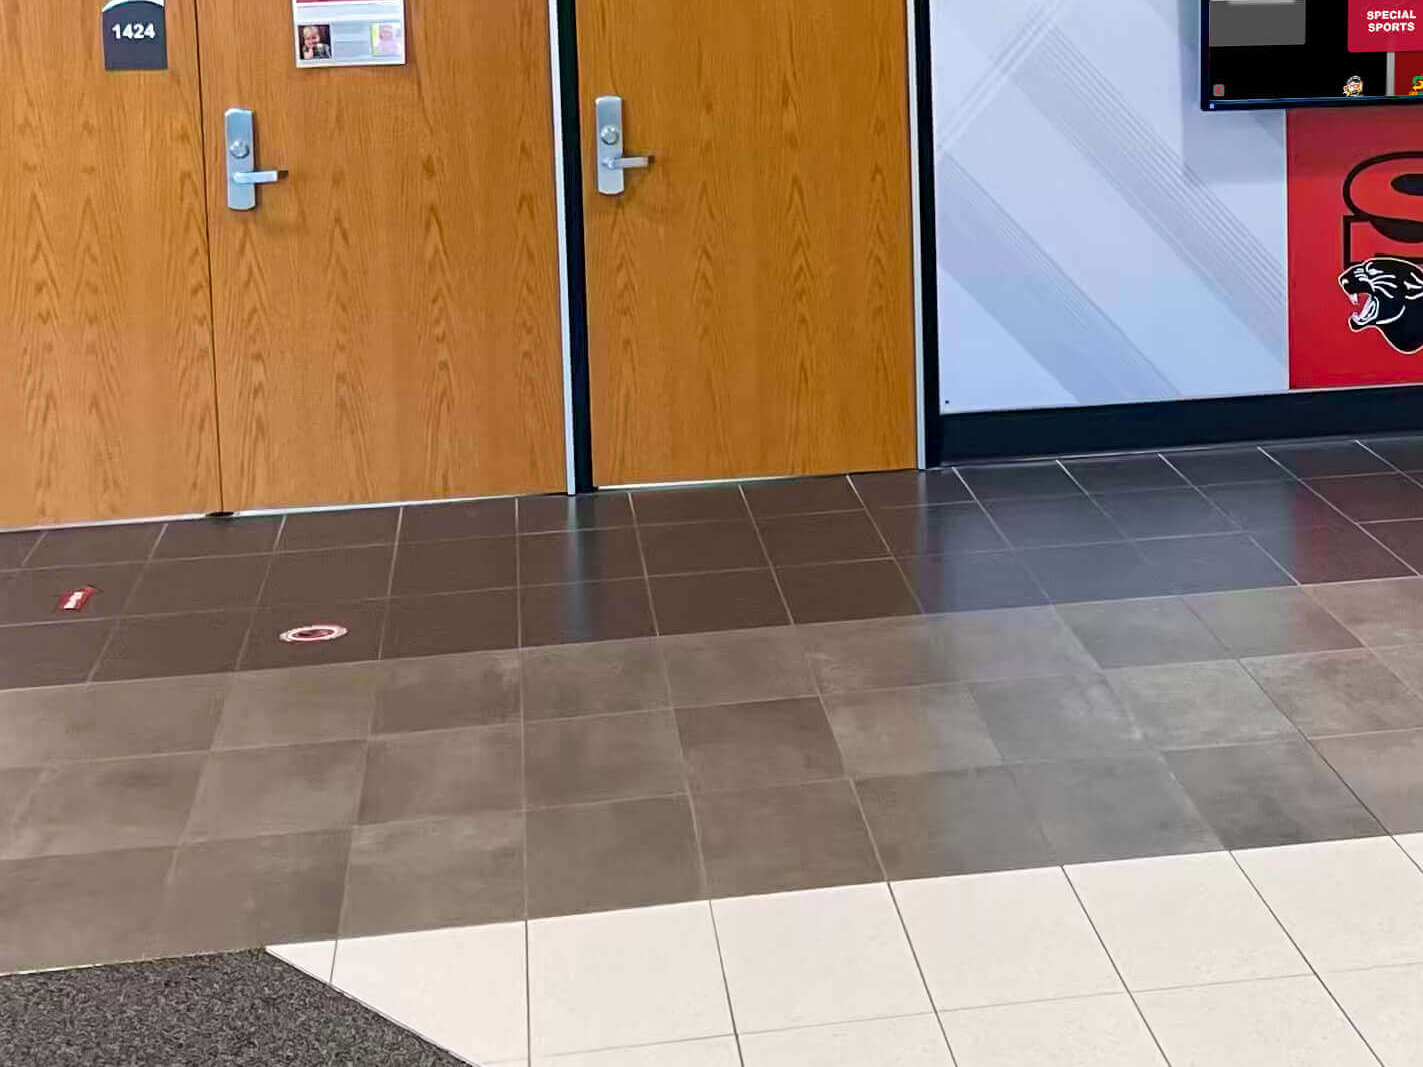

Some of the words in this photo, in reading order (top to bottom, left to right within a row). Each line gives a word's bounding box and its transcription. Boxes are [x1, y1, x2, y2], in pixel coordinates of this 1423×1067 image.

[1367, 10, 1416, 20] SPECIAL
[112, 23, 156, 39] 1424
[1368, 22, 1415, 33] SPORTS
